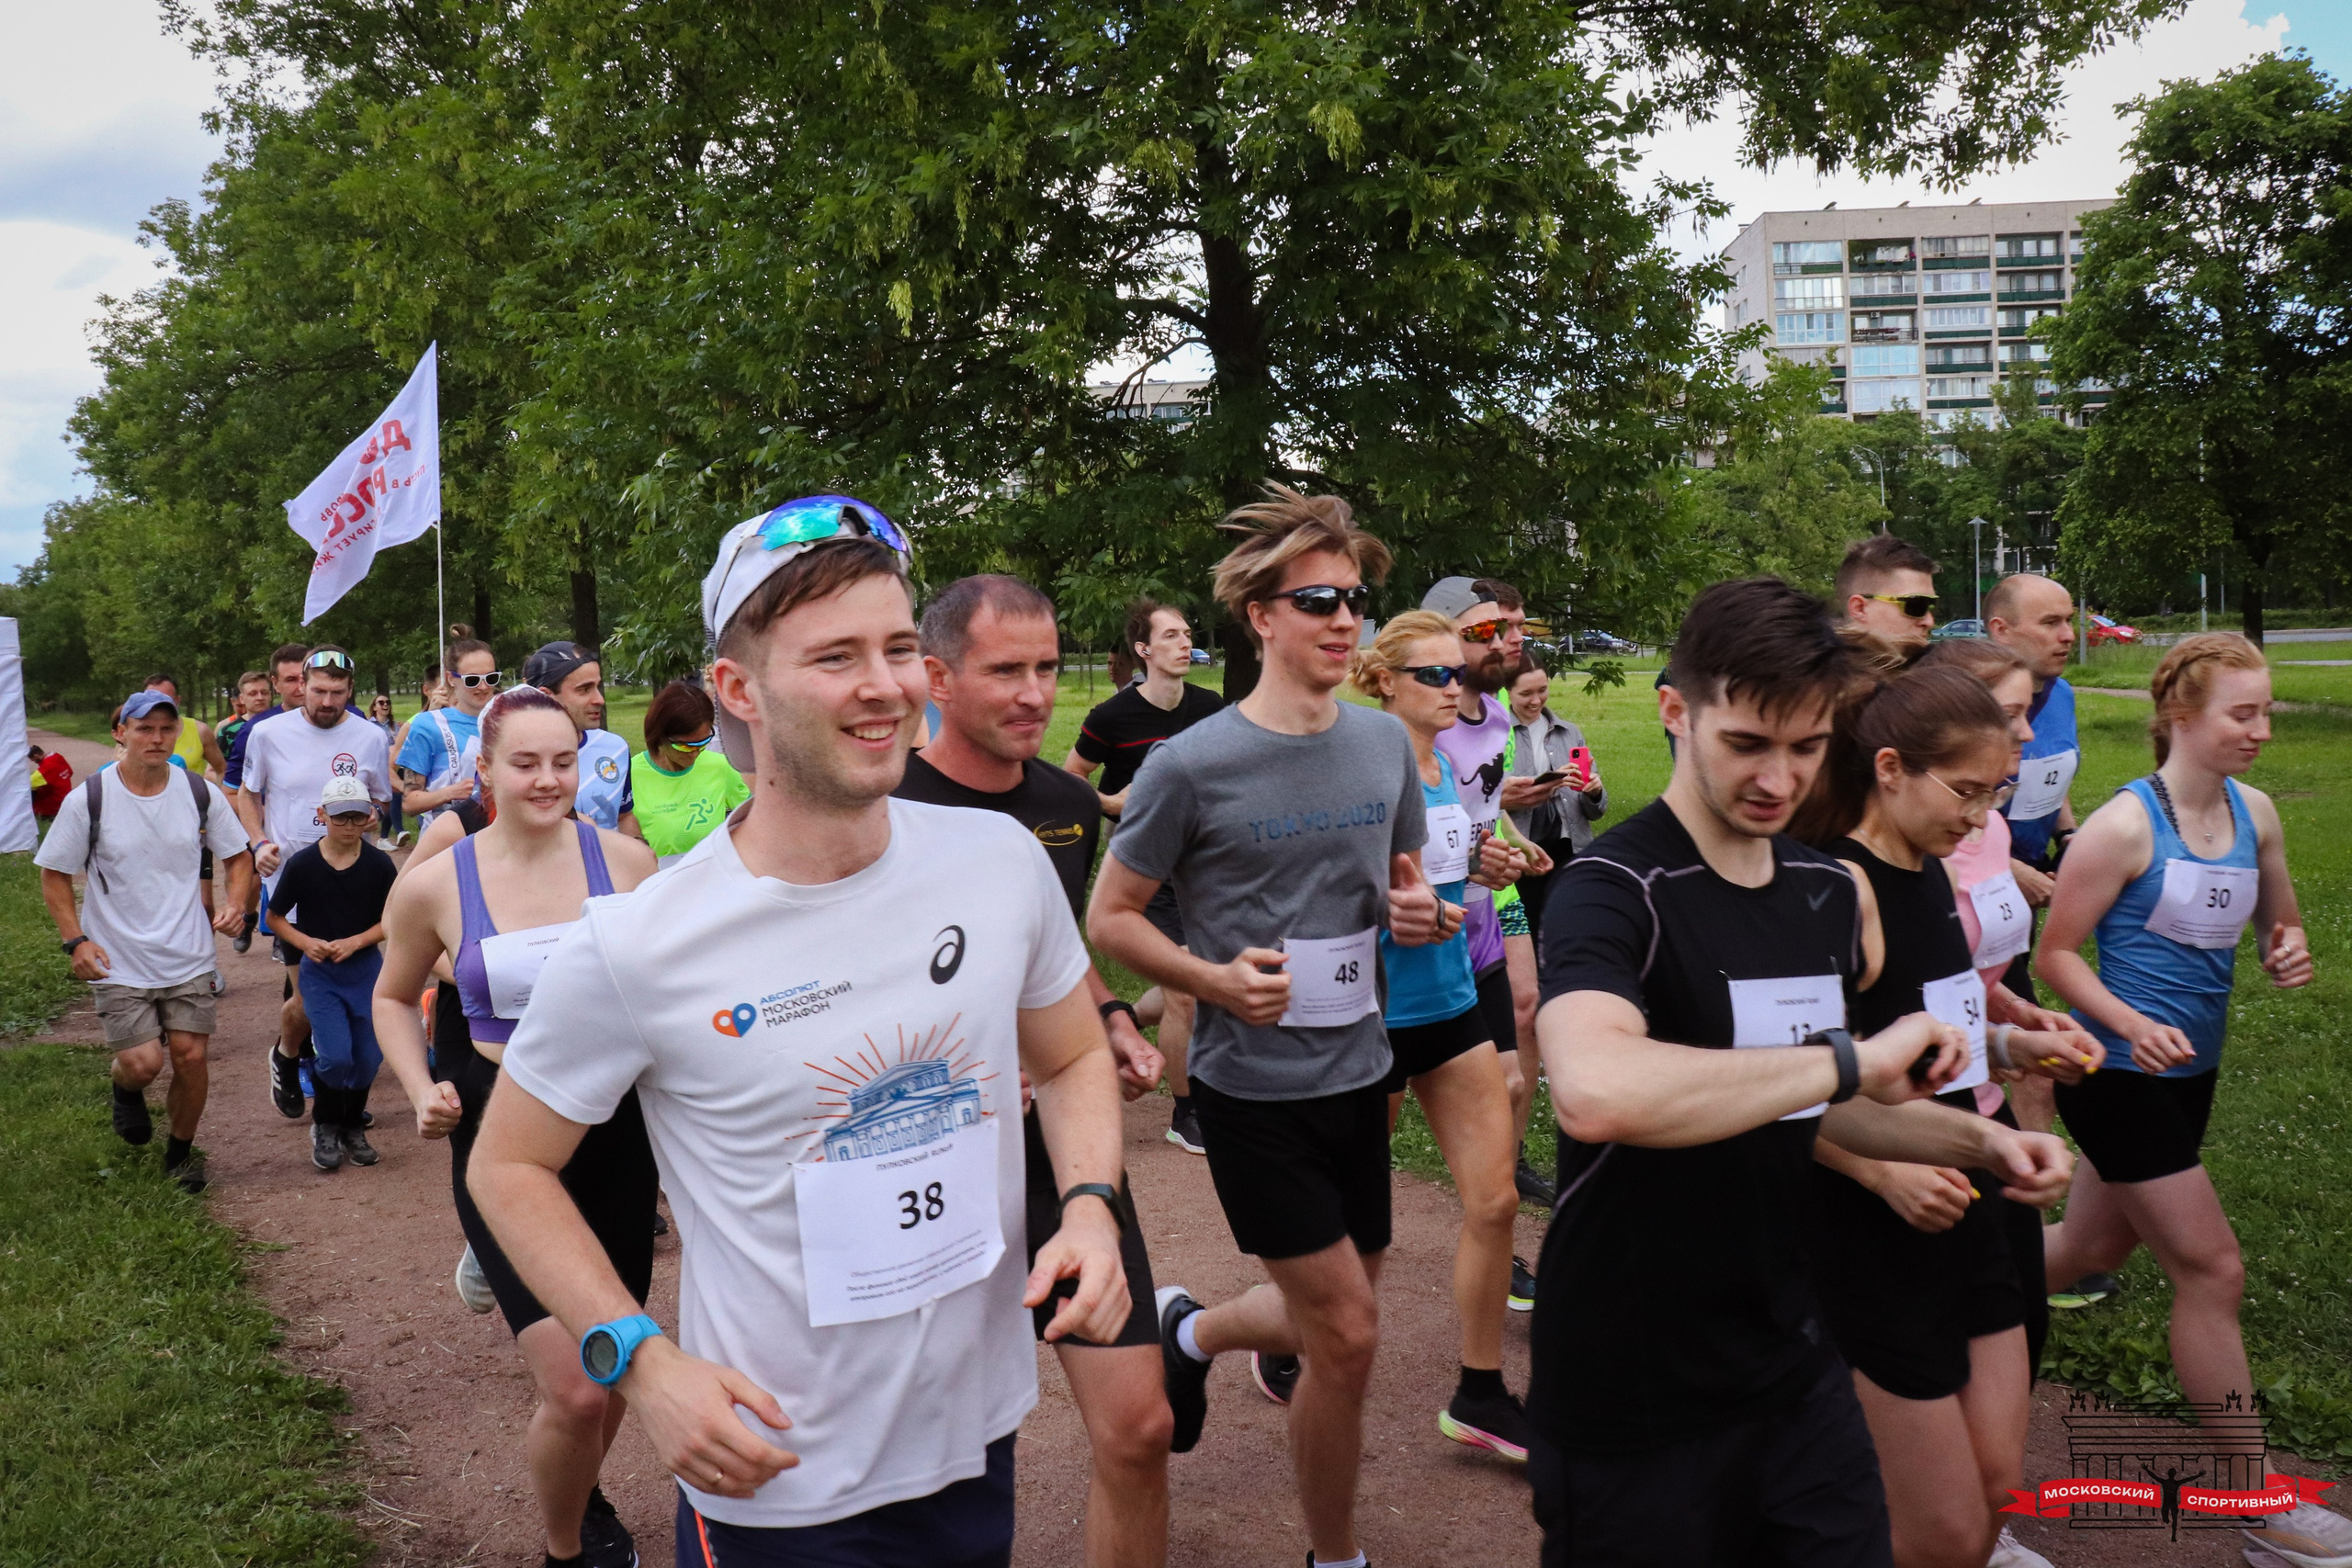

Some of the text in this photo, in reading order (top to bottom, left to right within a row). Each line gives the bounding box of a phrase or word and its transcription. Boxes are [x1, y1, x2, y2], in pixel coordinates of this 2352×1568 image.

[444, 732, 458, 769] CAUCASUS
[2044, 770, 2059, 786] 42
[1337, 801, 1386, 829] 2020
[1446, 829, 1459, 849] 67
[2207, 887, 2231, 909] 30
[1334, 960, 1359, 985] 48
[760, 980, 820, 1005] АБСОЛЮТ
[762, 980, 854, 1017] МОСКОВСКИЙ
[765, 1001, 831, 1028] МАРАФОН
[898, 1181, 944, 1230] 38
